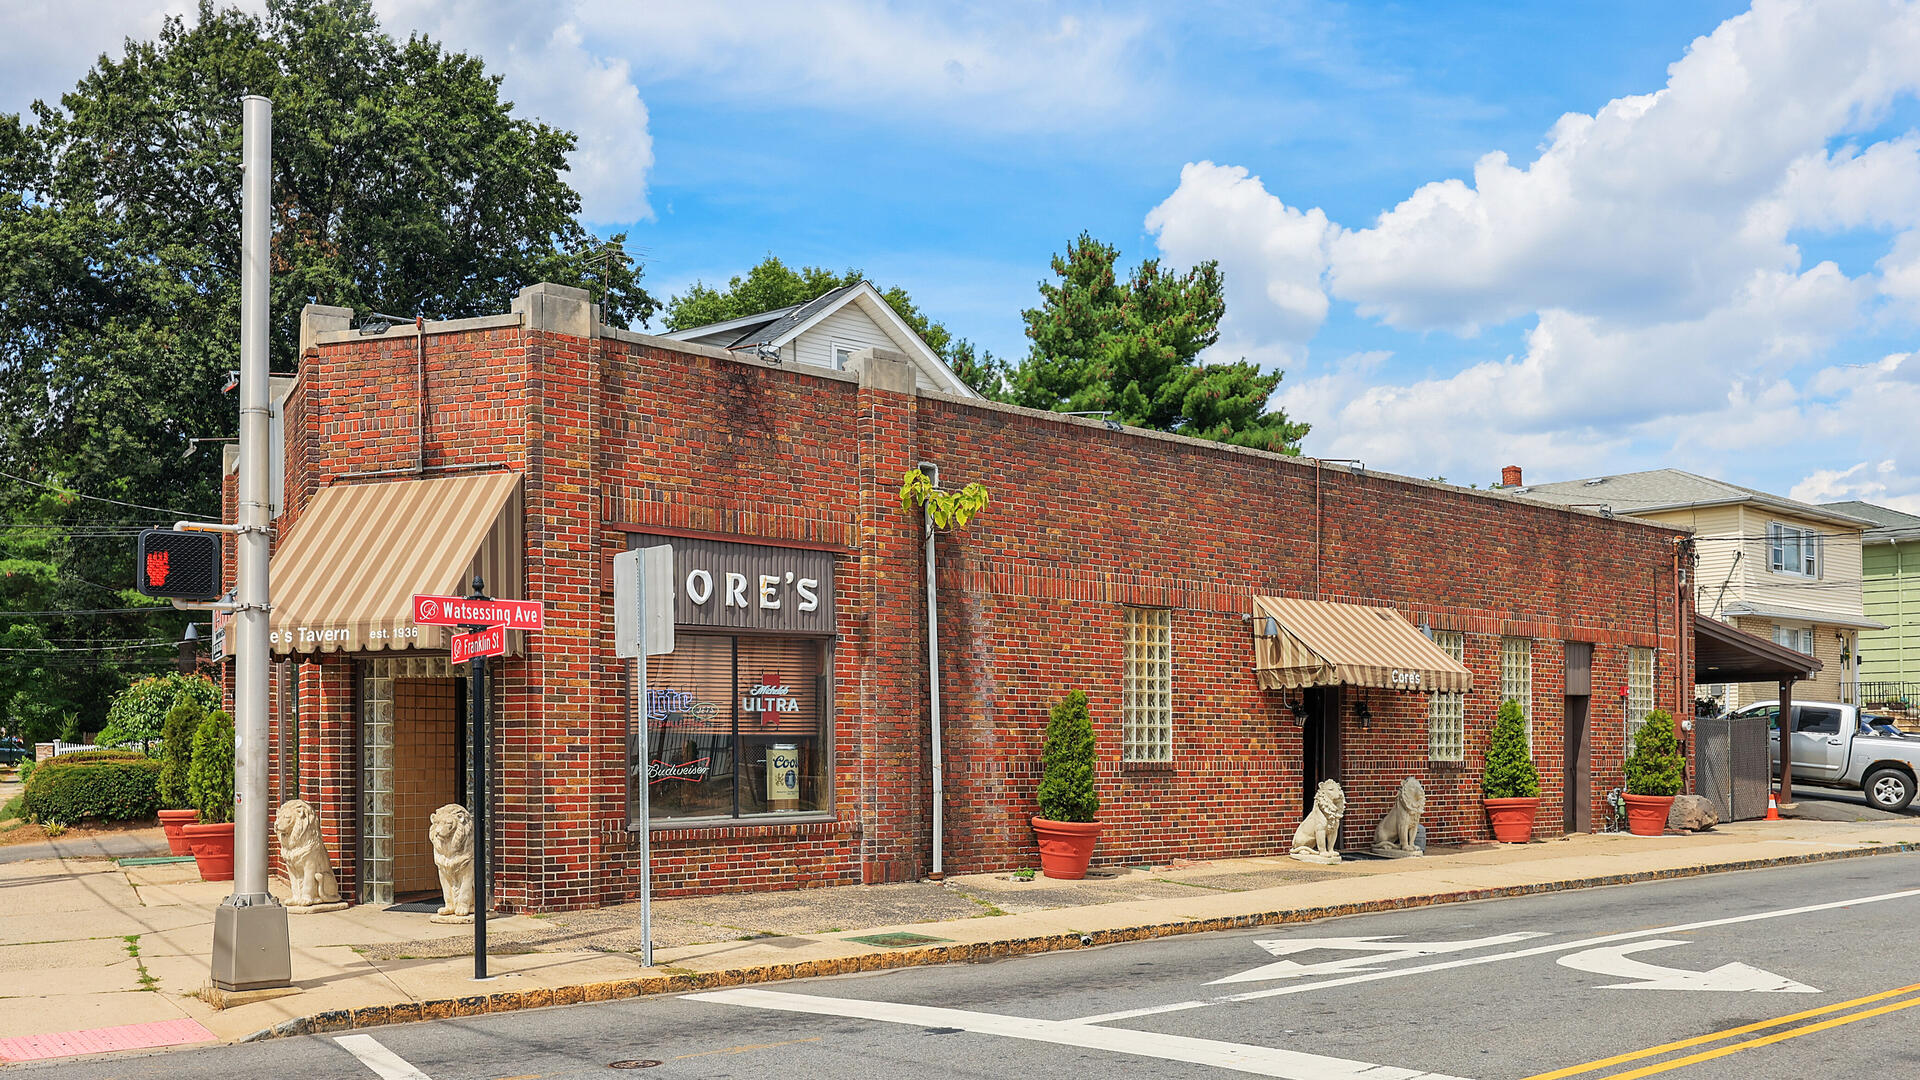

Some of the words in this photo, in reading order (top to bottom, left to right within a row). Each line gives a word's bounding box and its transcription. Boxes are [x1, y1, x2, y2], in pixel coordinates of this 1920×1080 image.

[686, 569, 819, 612] ORE'S
[443, 601, 511, 626] Watsessing
[515, 606, 538, 623] Ave
[269, 629, 293, 643] e's
[297, 627, 350, 643] Tavern
[369, 628, 390, 639] est.
[393, 626, 418, 638] 1936
[464, 634, 491, 655] Franklin
[492, 631, 499, 649] St
[1391, 669, 1420, 684] Core's
[647, 689, 693, 721] Lite
[742, 697, 800, 712] ULTRA
[647, 763, 710, 778] Budweiser
